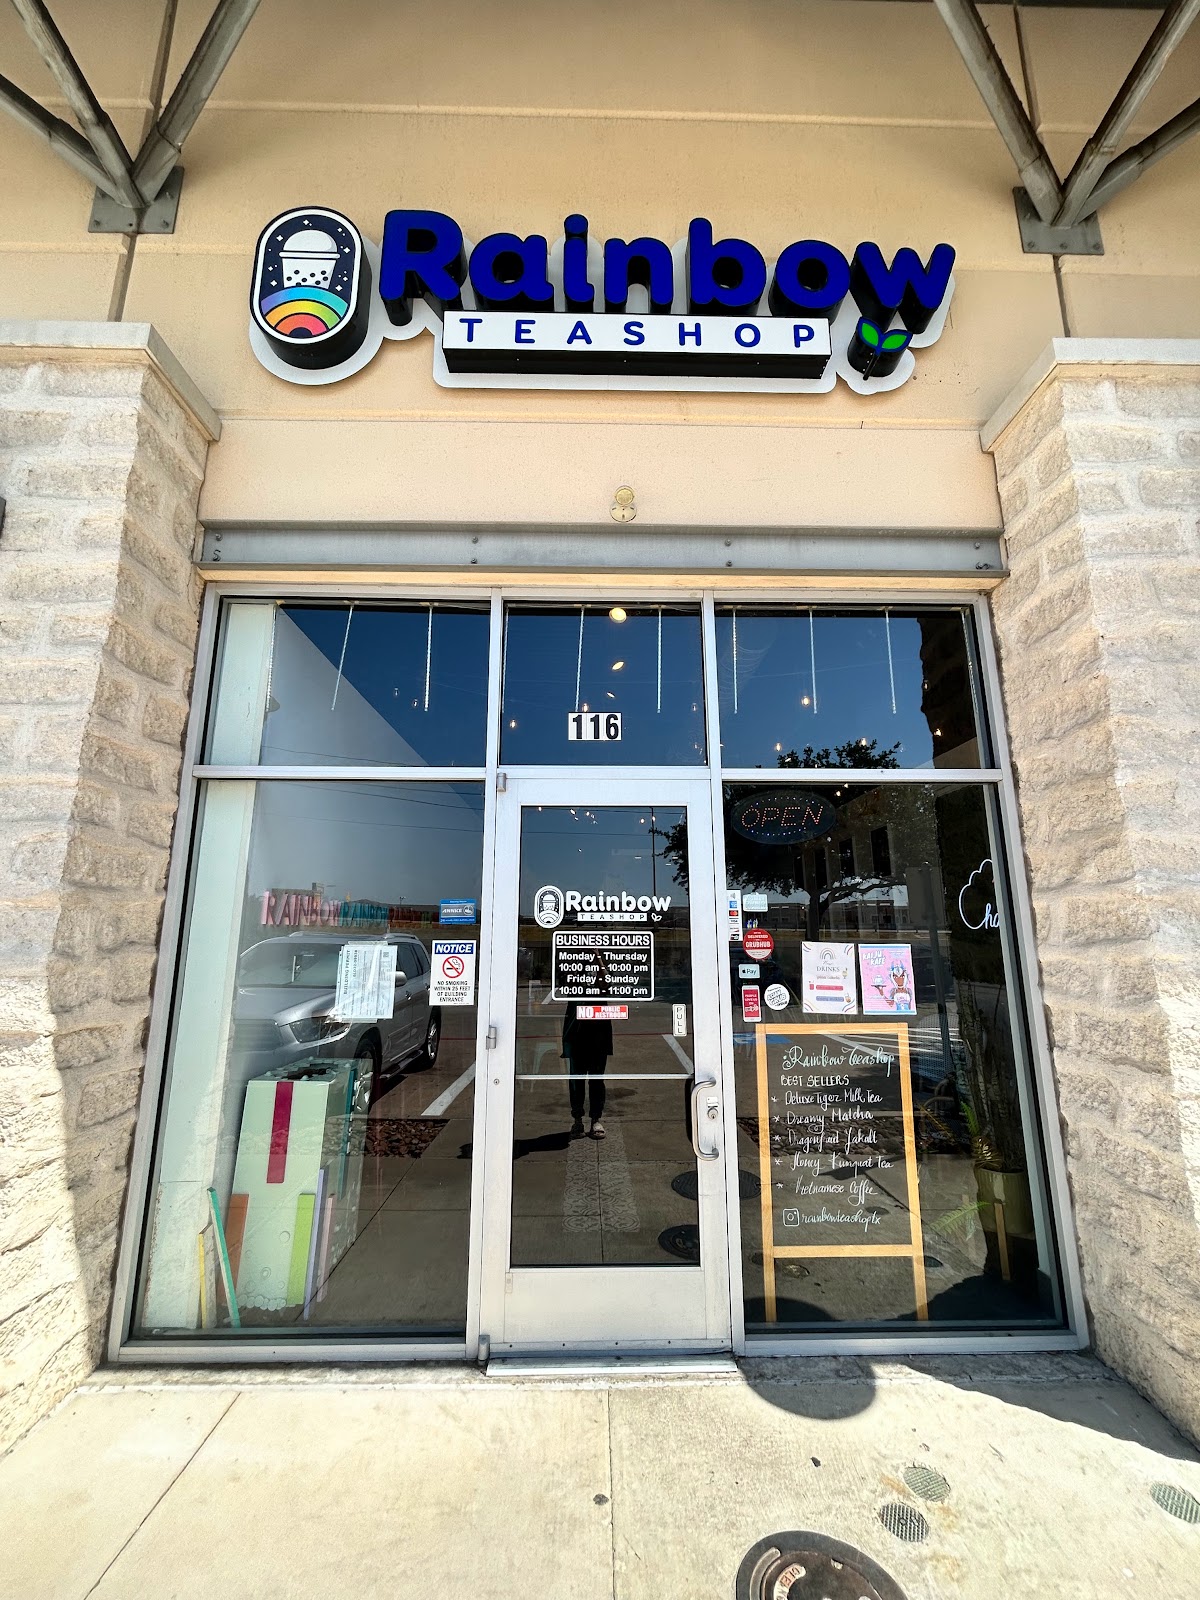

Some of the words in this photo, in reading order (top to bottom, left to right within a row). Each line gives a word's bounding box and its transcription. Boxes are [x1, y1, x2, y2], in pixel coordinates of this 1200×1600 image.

[379, 209, 956, 309] Rainbow
[458, 316, 817, 349] TEASHOP
[572, 713, 619, 740] 116
[741, 804, 824, 829] OPEN
[261, 890, 340, 927] RAINBOW
[565, 890, 672, 912] Rainbow
[435, 944, 473, 954] NOTICE
[556, 935, 610, 946] BUSINESS
[611, 935, 650, 946] HOURS
[559, 952, 595, 962] Monday
[603, 952, 648, 962] Thursday
[559, 963, 583, 972] 10:00
[584, 964, 600, 972] am
[607, 963, 632, 972] 10:00
[633, 964, 648, 973] pm
[567, 974, 597, 984] Friday
[604, 974, 639, 984] Sunday
[559, 986, 584, 995] 10:00
[608, 986, 632, 995] 11:00
[632, 987, 648, 996] pm
[578, 1006, 594, 1018] NO
[782, 1044, 846, 1071] Rainbow
[841, 1046, 895, 1078] Teashop
[781, 1074, 803, 1087] BEST
[806, 1074, 850, 1087] SELLERS
[785, 1090, 814, 1105] Deluxe
[843, 1087, 865, 1103] Milk
[866, 1089, 883, 1103] Tea
[787, 1111, 825, 1134] Dreamy
[831, 1105, 874, 1122] Matcha
[875, 1155, 895, 1169] Tea
[847, 1178, 879, 1207] Coffee
